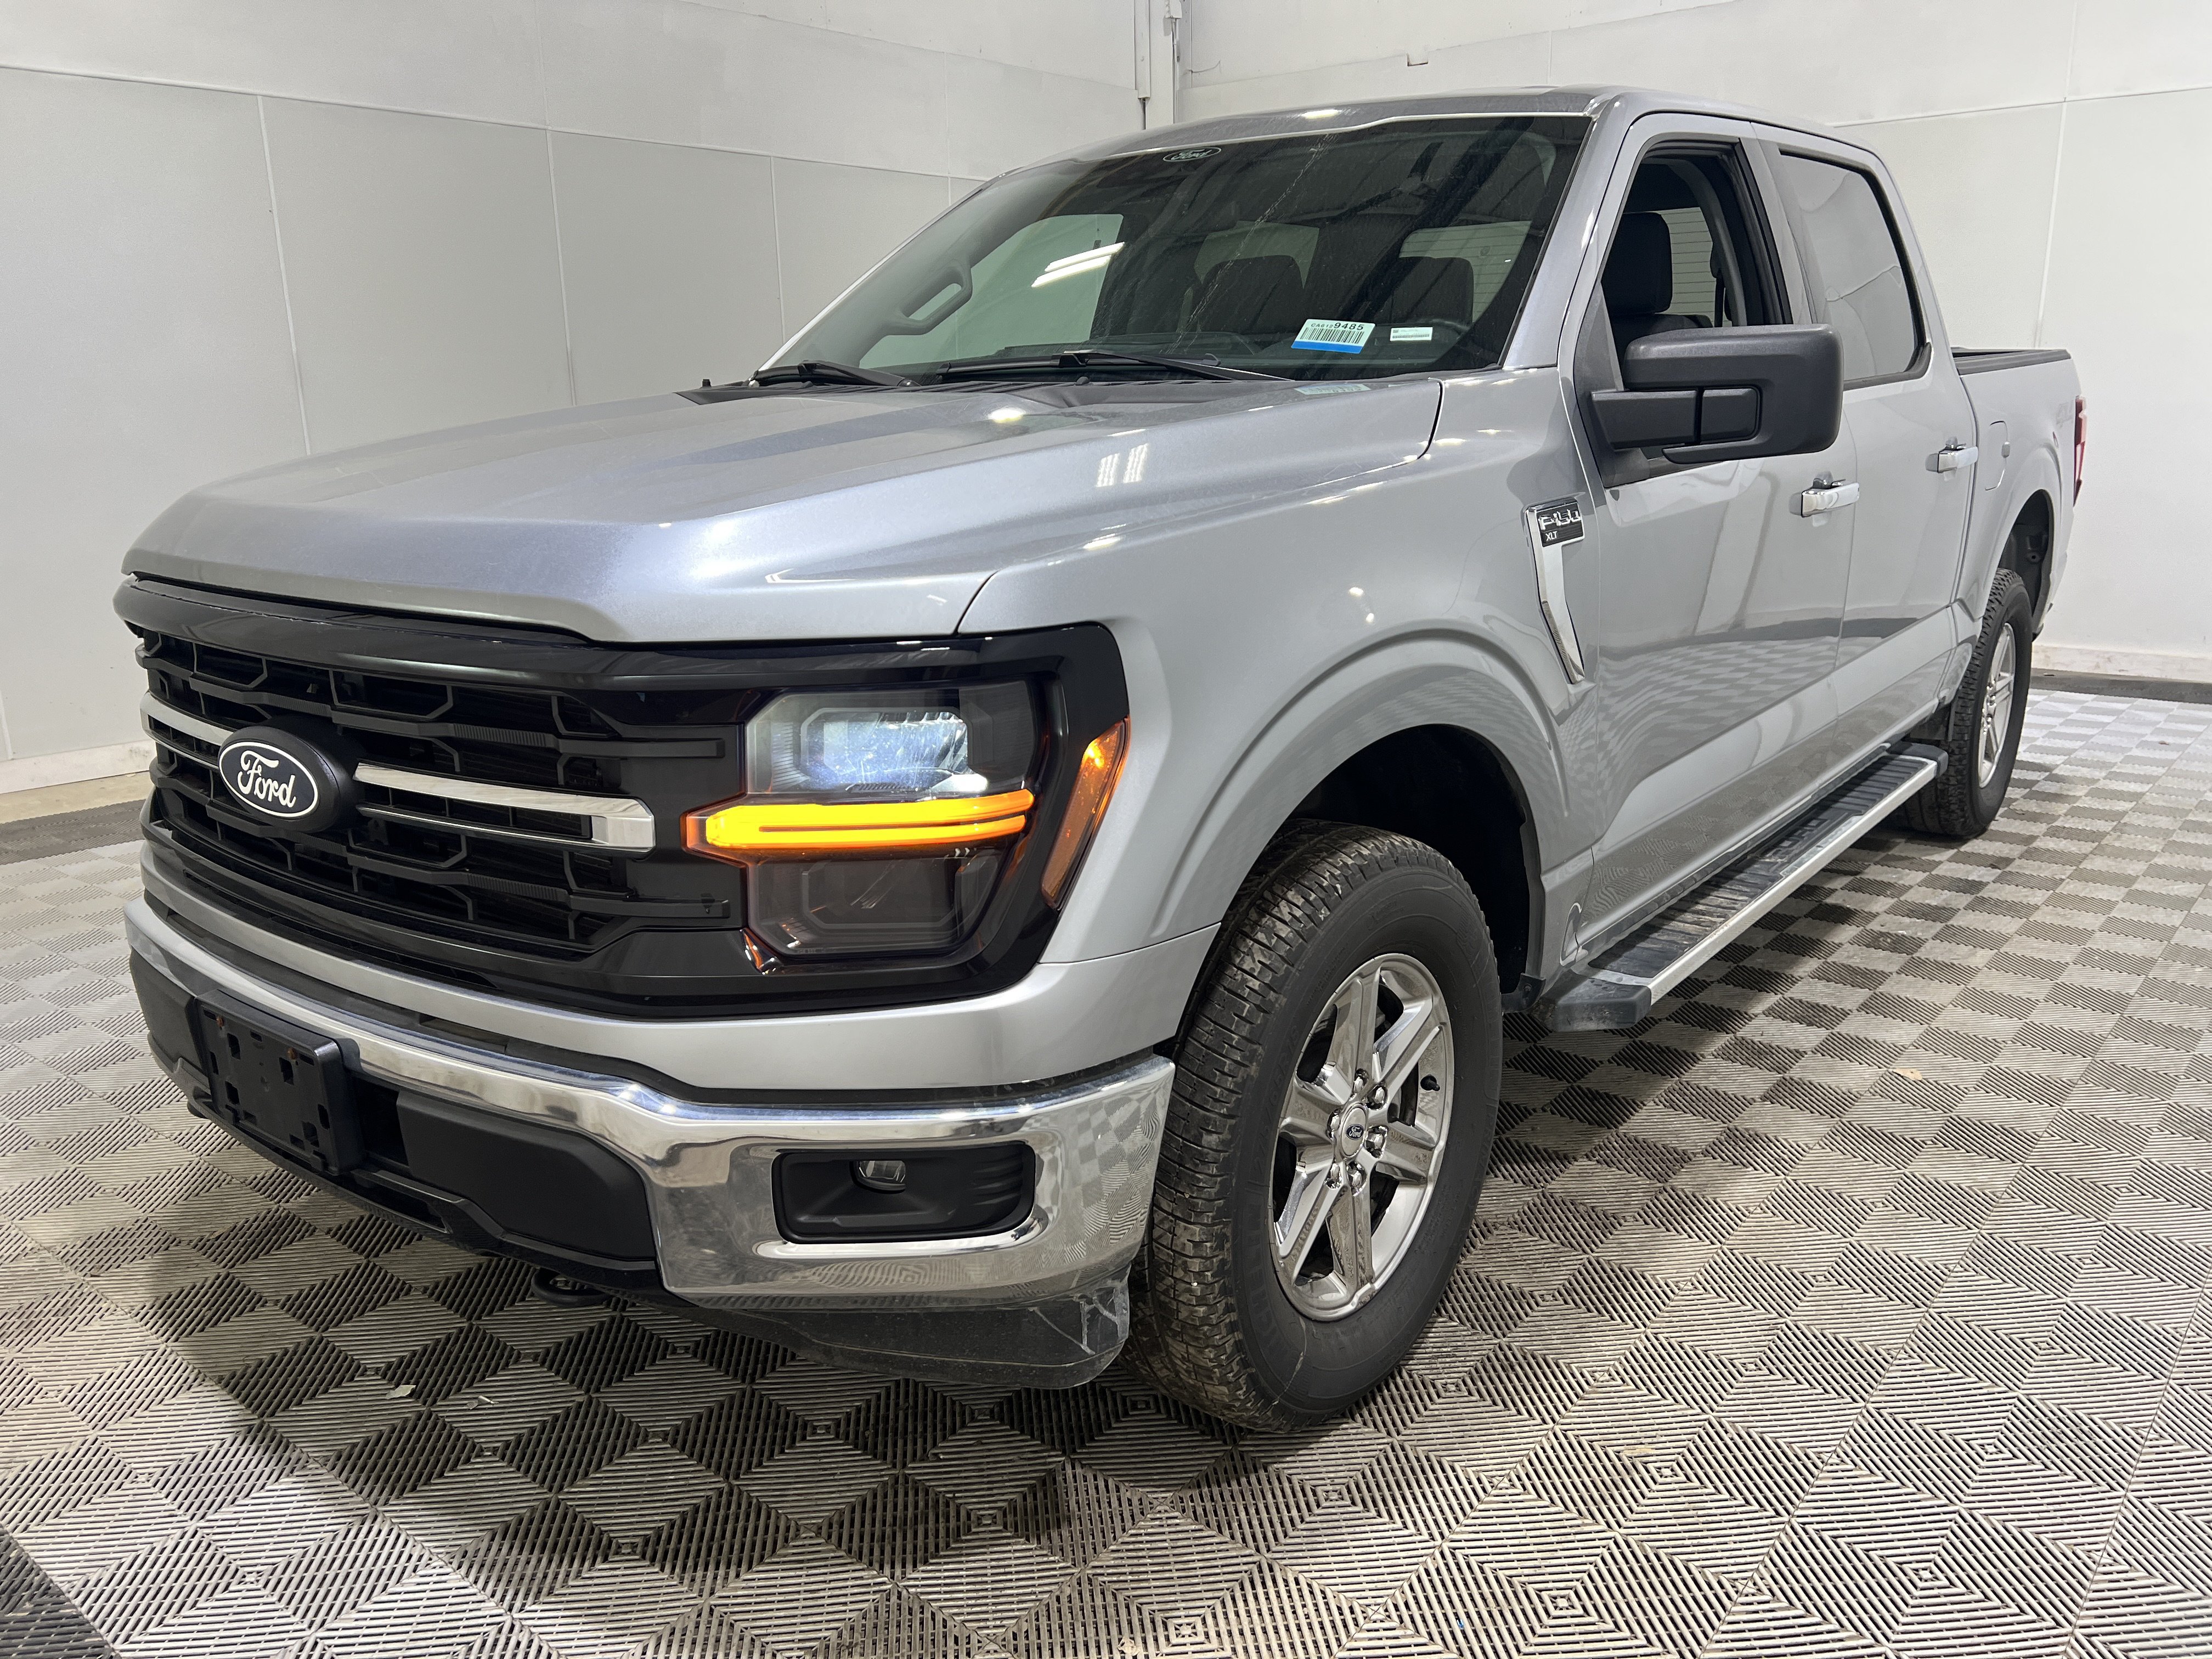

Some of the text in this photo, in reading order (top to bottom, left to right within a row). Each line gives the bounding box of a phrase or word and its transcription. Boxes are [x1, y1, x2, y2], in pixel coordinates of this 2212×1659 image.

[1170, 148, 1213, 161] Ford
[1545, 531, 1558, 541] XLT
[237, 749, 297, 808] Ford
[1348, 1126, 1362, 1138] Ford
